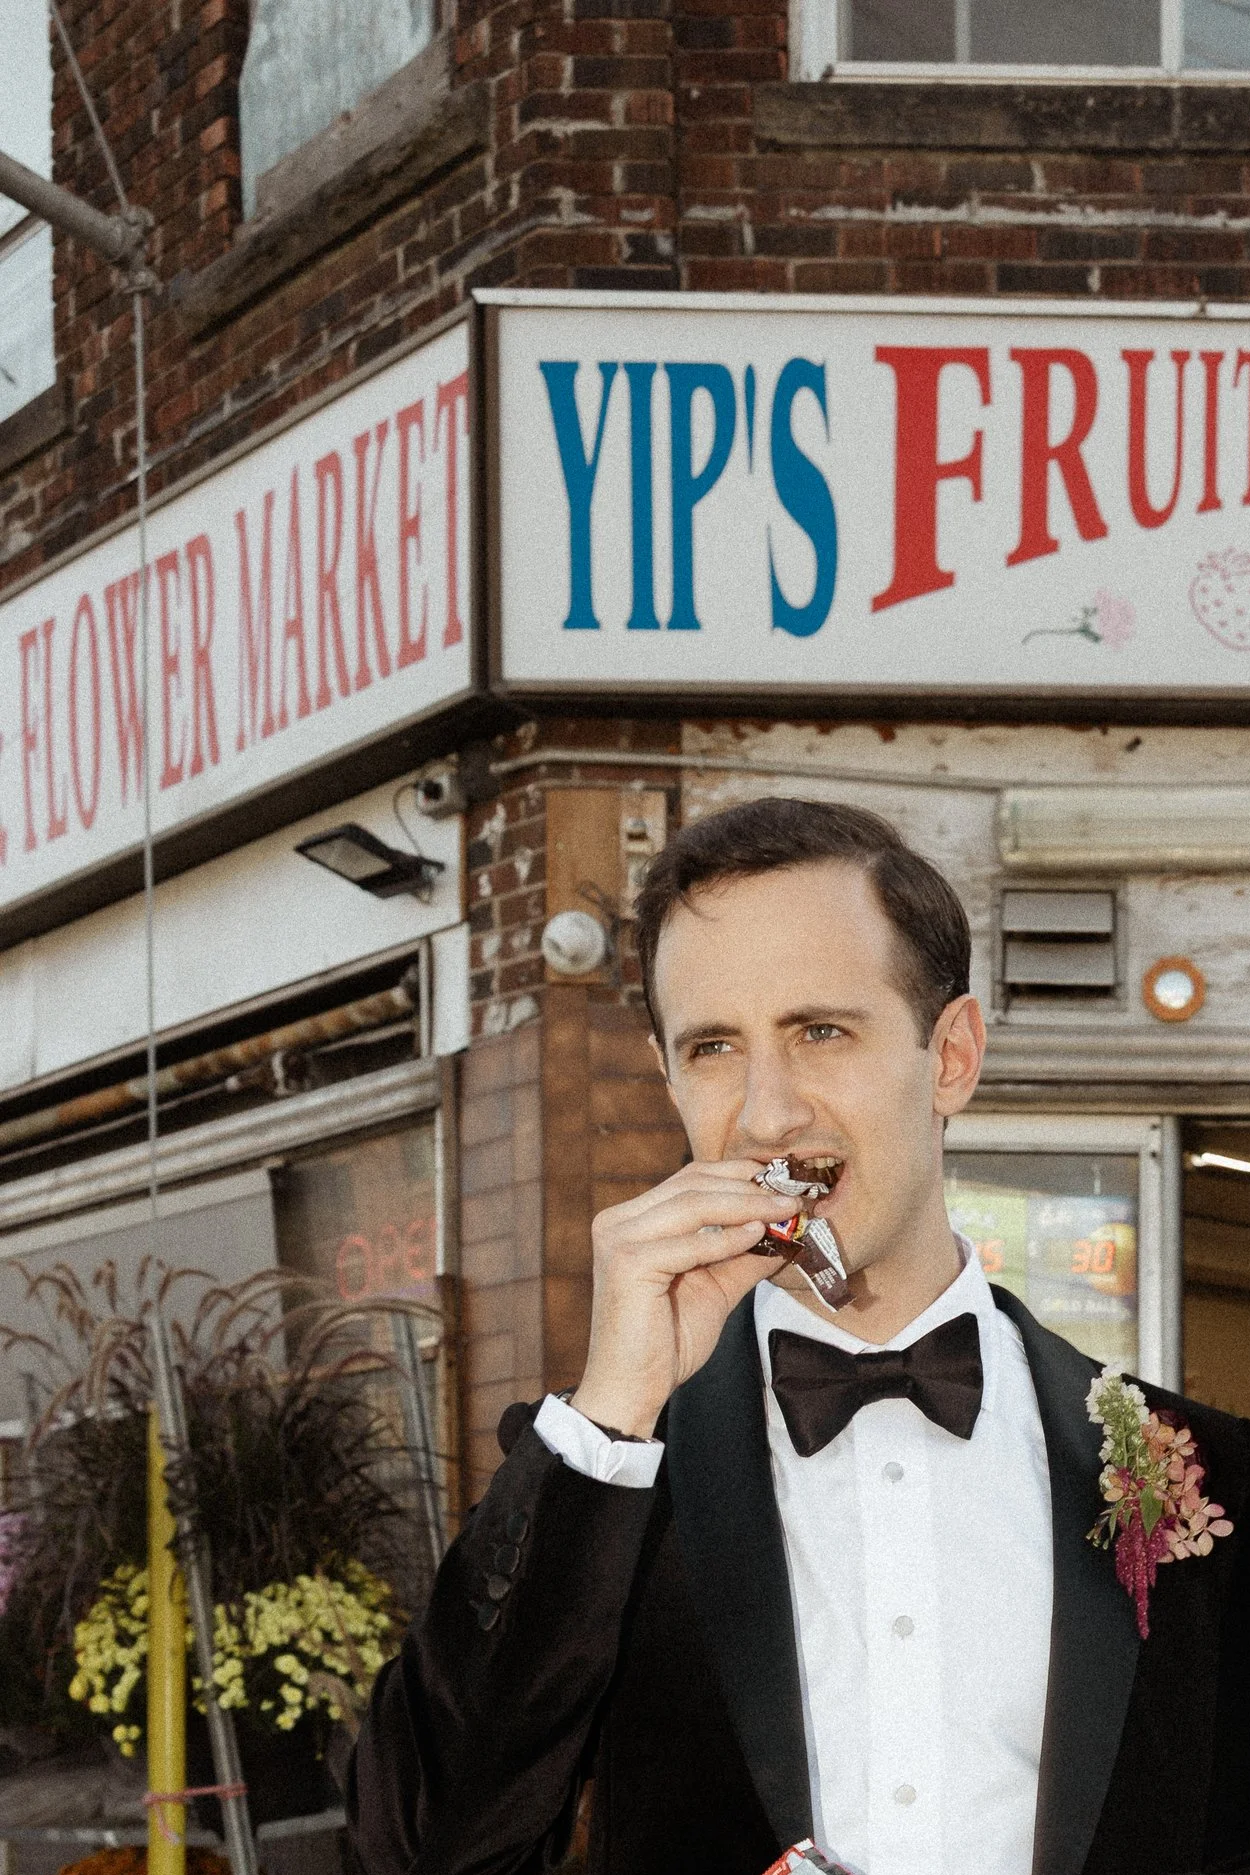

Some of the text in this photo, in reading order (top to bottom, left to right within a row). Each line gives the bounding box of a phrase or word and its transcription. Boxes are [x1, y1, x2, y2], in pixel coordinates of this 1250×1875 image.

[538, 356, 840, 639] YIP'S
[18, 371, 469, 852] FLOWER MARKET
[338, 1219, 437, 1301] OPE
[1071, 1238, 1117, 1275] 30
